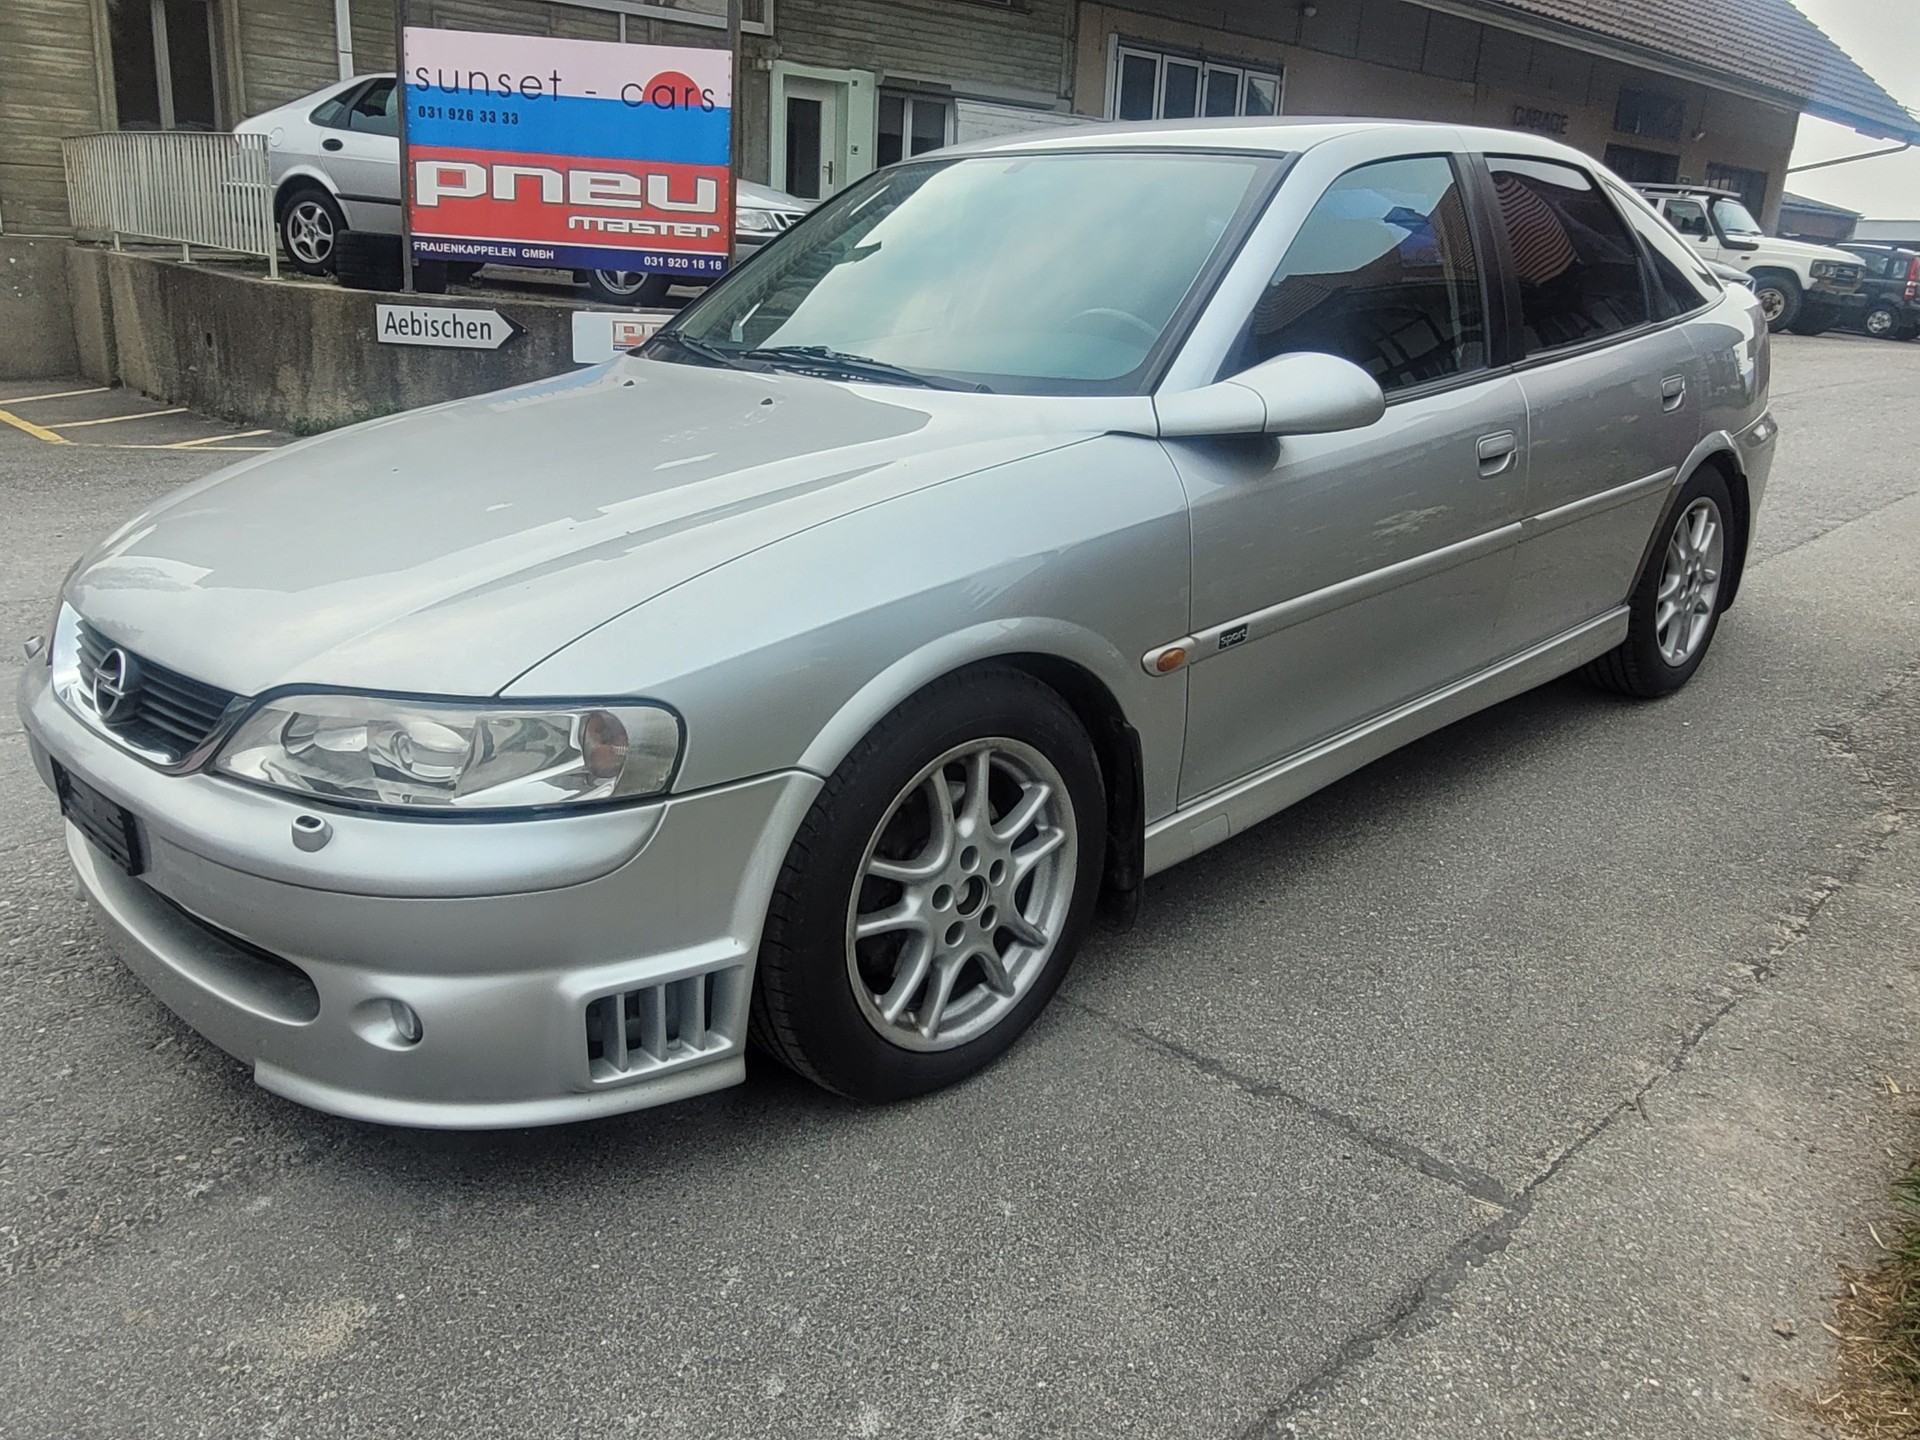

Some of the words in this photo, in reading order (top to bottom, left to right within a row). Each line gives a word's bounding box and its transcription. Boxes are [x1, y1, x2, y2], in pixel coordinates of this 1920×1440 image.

[415, 67, 562, 102] sunset
[620, 82, 716, 113] cars
[418, 105, 443, 119] 031
[448, 107, 474, 122] 926
[480, 110, 496, 123] 33
[502, 112, 519, 125] 33
[568, 215, 721, 238] master
[413, 241, 517, 257] FRAUENKAPPELEN
[521, 248, 554, 260] GMBH
[643, 256, 664, 267] 031
[667, 257, 689, 269] 920
[692, 259, 705, 270] 18
[709, 260, 722, 271] 18
[384, 311, 492, 341] Aebischen
[1220, 628, 1248, 647] sport
